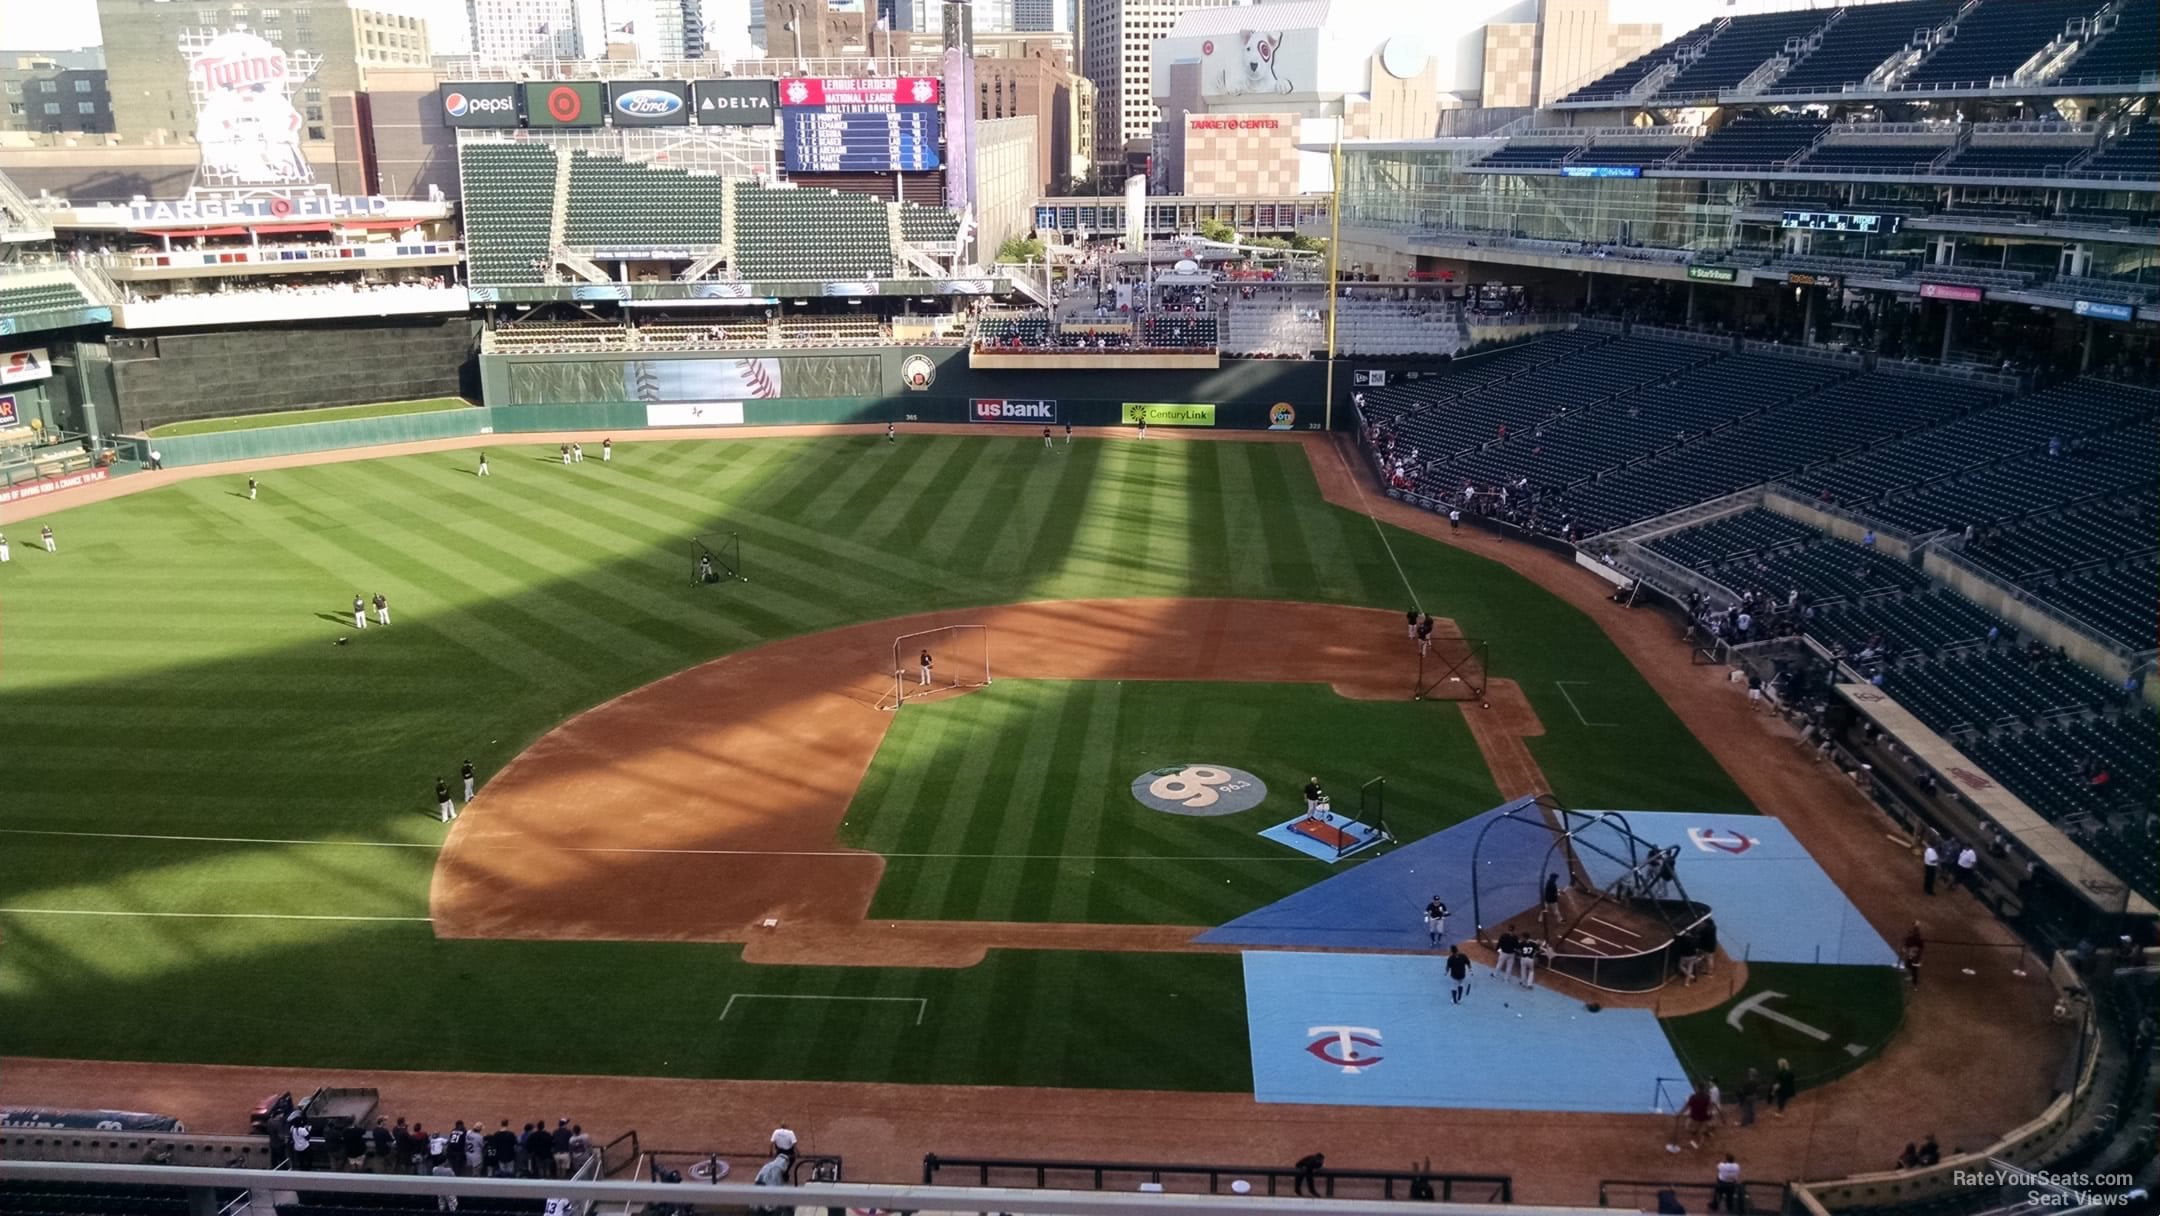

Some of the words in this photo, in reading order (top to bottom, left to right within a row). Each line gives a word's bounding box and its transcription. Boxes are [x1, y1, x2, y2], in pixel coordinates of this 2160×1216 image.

[193, 56, 284, 92] Twins
[469, 94, 514, 114] pepsi
[629, 94, 669, 113] Ford
[719, 97, 769, 109] DELTA
[825, 93, 863, 103] NATIONAL
[865, 93, 894, 103] LEAGUE
[826, 104, 849, 113] MULTI
[1190, 120, 1227, 129] TARGET
[1240, 119, 1279, 129] CENTER
[132, 198, 265, 221] TARGET
[300, 195, 389, 218] FIELD
[1150, 405, 1207, 420] CenturyLink
[60, 476, 83, 488] CHANCE
